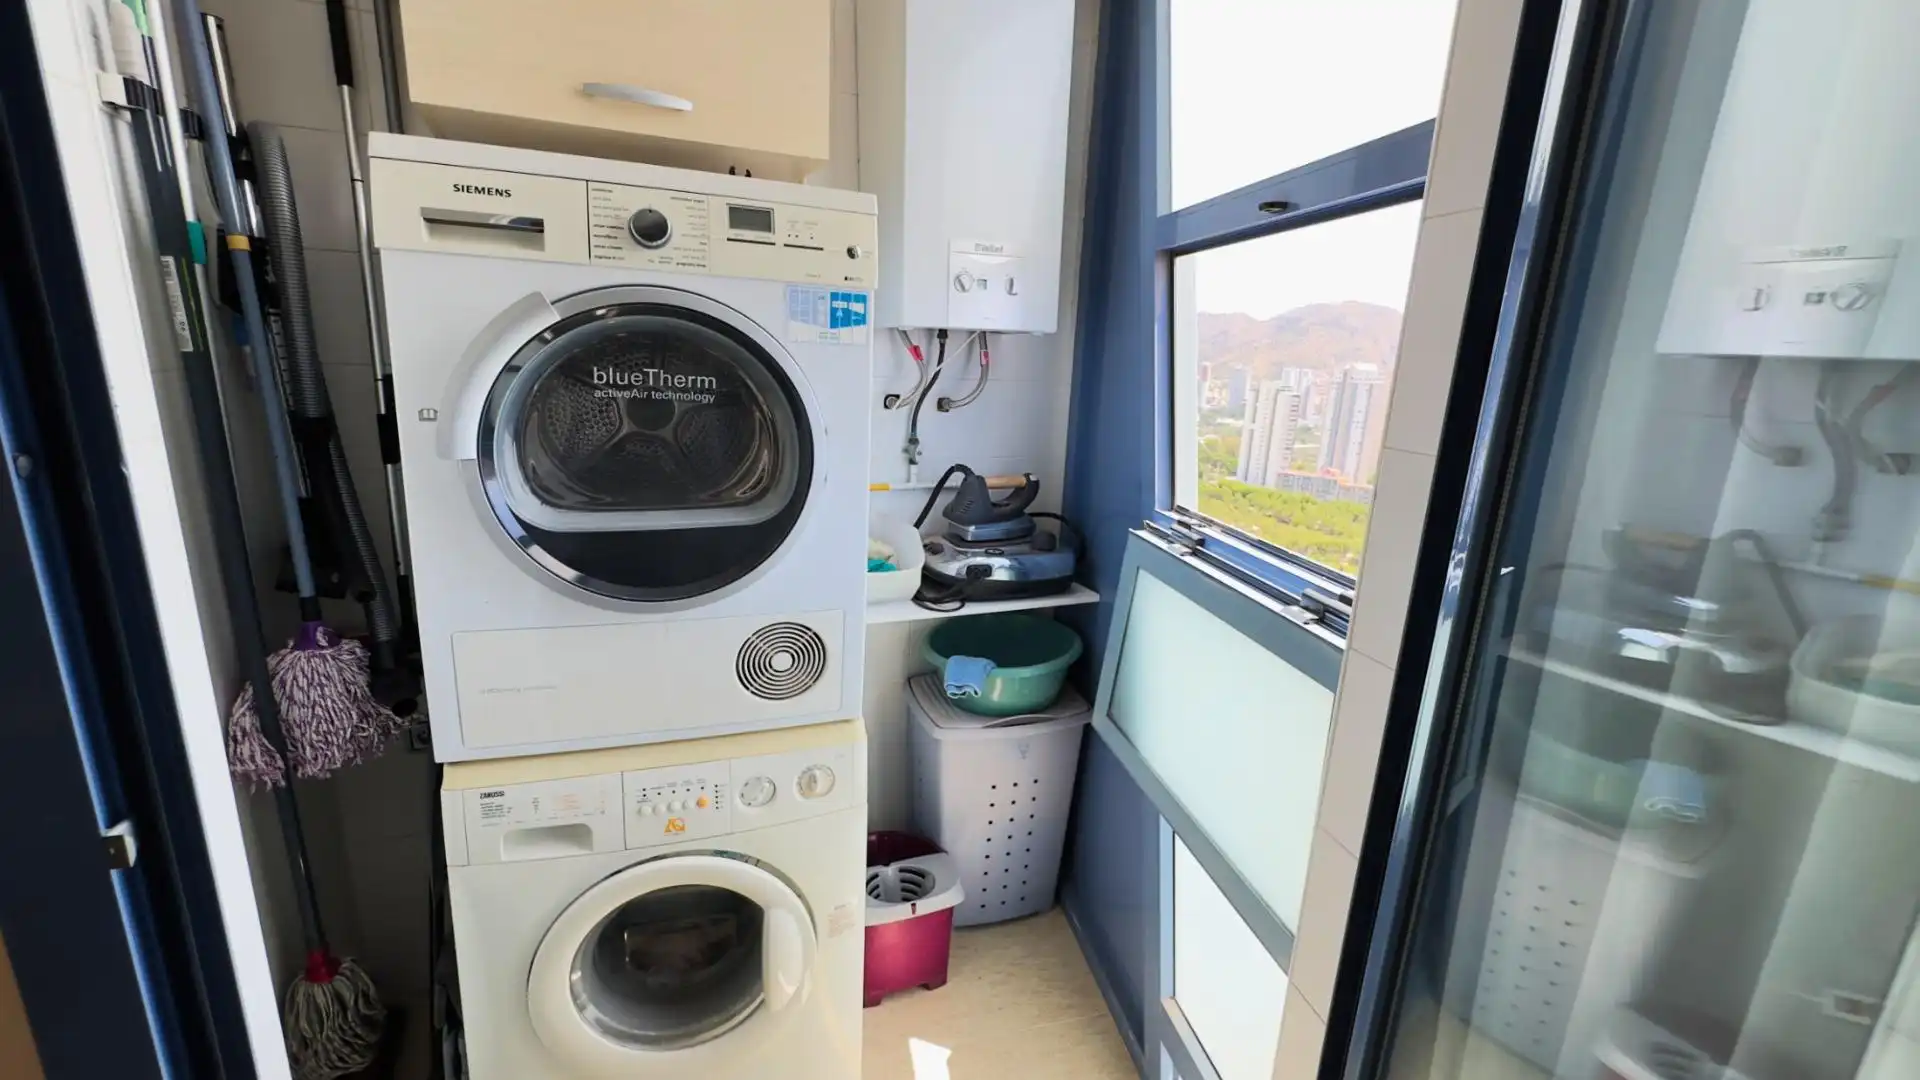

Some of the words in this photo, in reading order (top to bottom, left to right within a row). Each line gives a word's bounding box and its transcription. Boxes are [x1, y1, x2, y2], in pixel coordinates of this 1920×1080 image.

[453, 183, 512, 198] SIEMENS
[593, 366, 717, 389] blueTherm
[594, 388, 649, 399] activeAir
[651, 389, 716, 404] technology
